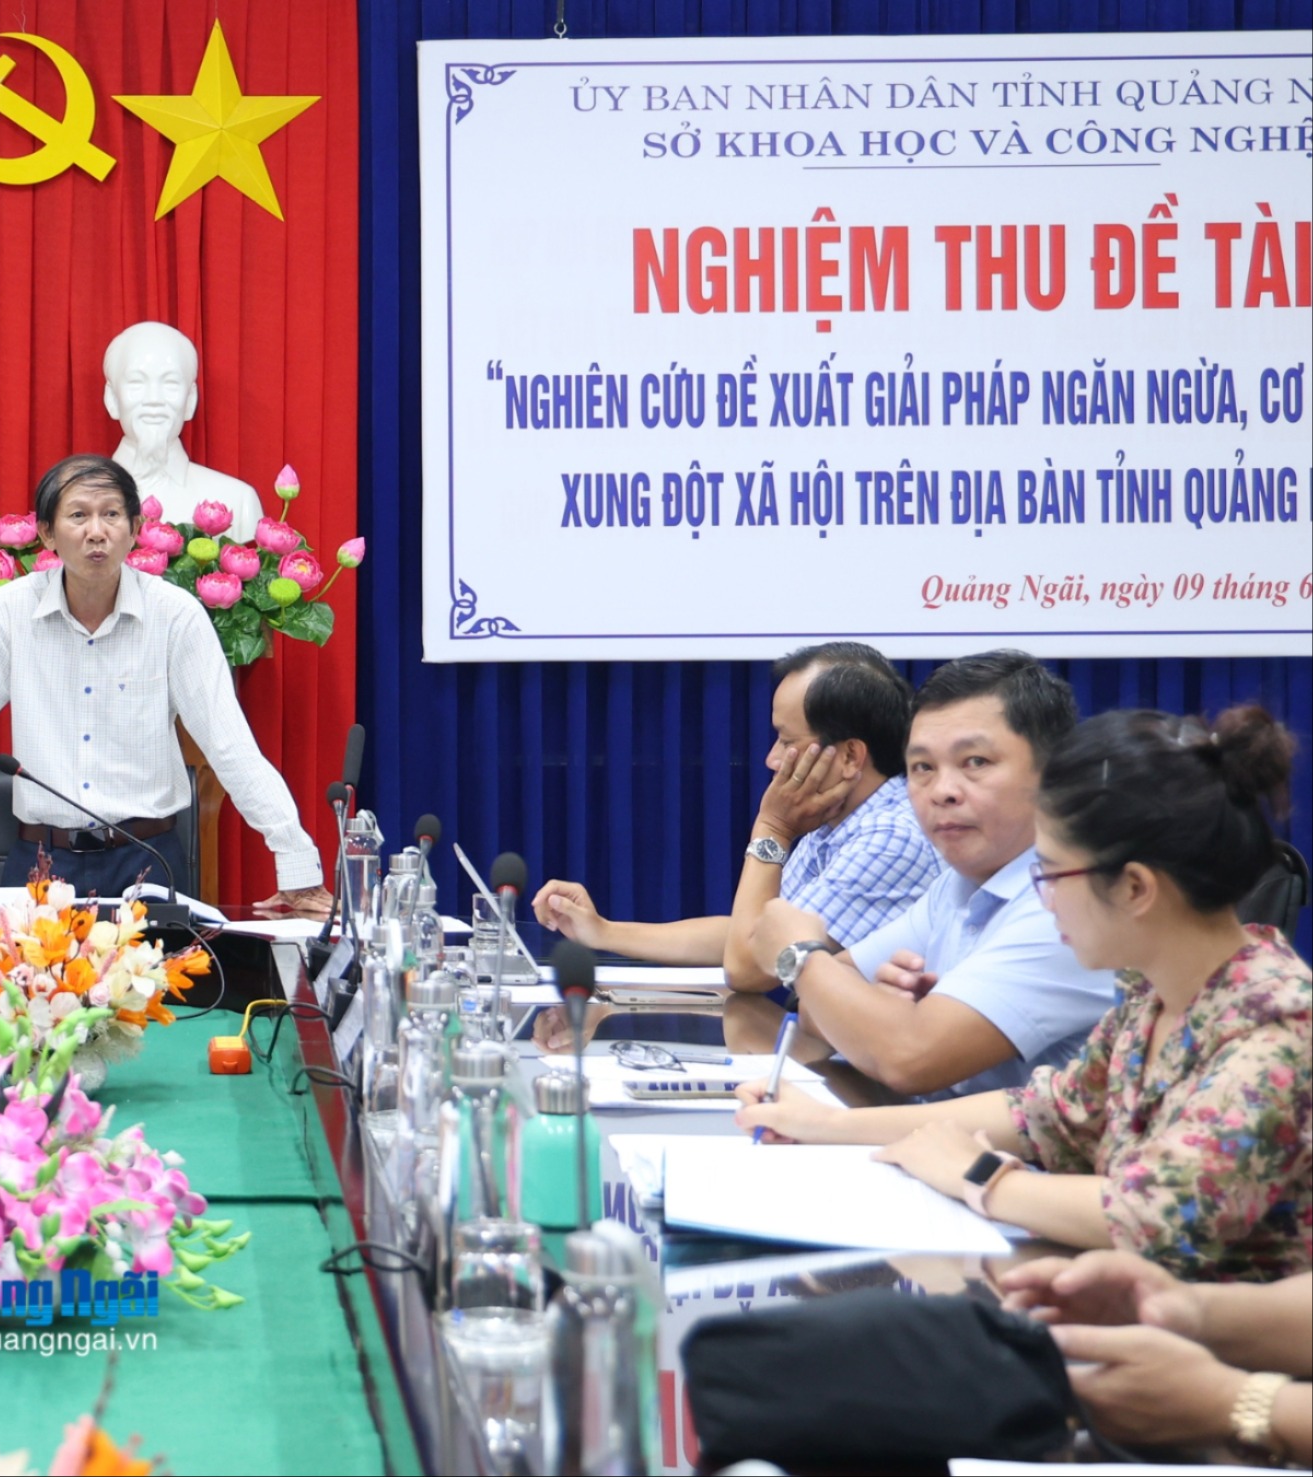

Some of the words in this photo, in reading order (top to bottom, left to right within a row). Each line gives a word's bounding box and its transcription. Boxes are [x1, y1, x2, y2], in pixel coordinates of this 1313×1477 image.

[569, 76, 631, 112] ỦY
[642, 85, 732, 111] BAN
[745, 76, 874, 110] NHÂN
[885, 75, 979, 109] DÂN
[991, 72, 1101, 108] TỈNH
[1115, 69, 1274, 113] QUẢNG
[643, 121, 702, 158] SỞ
[716, 130, 847, 157] KHOA
[859, 130, 957, 164] HỌC
[969, 120, 1033, 156] VÀ
[1045, 119, 1177, 155] CÔNG
[632, 207, 910, 333] NGHIỆM
[935, 224, 1066, 312] THU
[1091, 192, 1180, 310] ĐỀ
[1204, 201, 1312, 309] TÀI
[640, 361, 706, 429] CỨU
[716, 354, 758, 428] ĐỀ
[769, 351, 854, 428] XUẤT
[865, 352, 930, 428] GIẢI
[942, 358, 1030, 426] PHÁP
[1042, 358, 1135, 426] NGĂN
[1146, 356, 1248, 430] NGỪA,
[1259, 361, 1305, 424] CƠ
[560, 471, 651, 529] XUNG
[661, 460, 725, 540] ĐỘT
[734, 460, 780, 527] XÃ
[790, 458, 844, 539] HỘI
[854, 458, 940, 526] TRÊN
[949, 469, 1007, 538] ĐỊA
[1017, 457, 1086, 525] BÀN
[1095, 450, 1172, 524] TỈNH
[1183, 447, 1298, 530] QUẢNG
[921, 574, 1012, 610] Quảng
[1019, 574, 1090, 609] Ngãi,
[1099, 573, 1165, 608] ngày
[1173, 572, 1205, 601] 09
[1212, 572, 1290, 608] tháng
